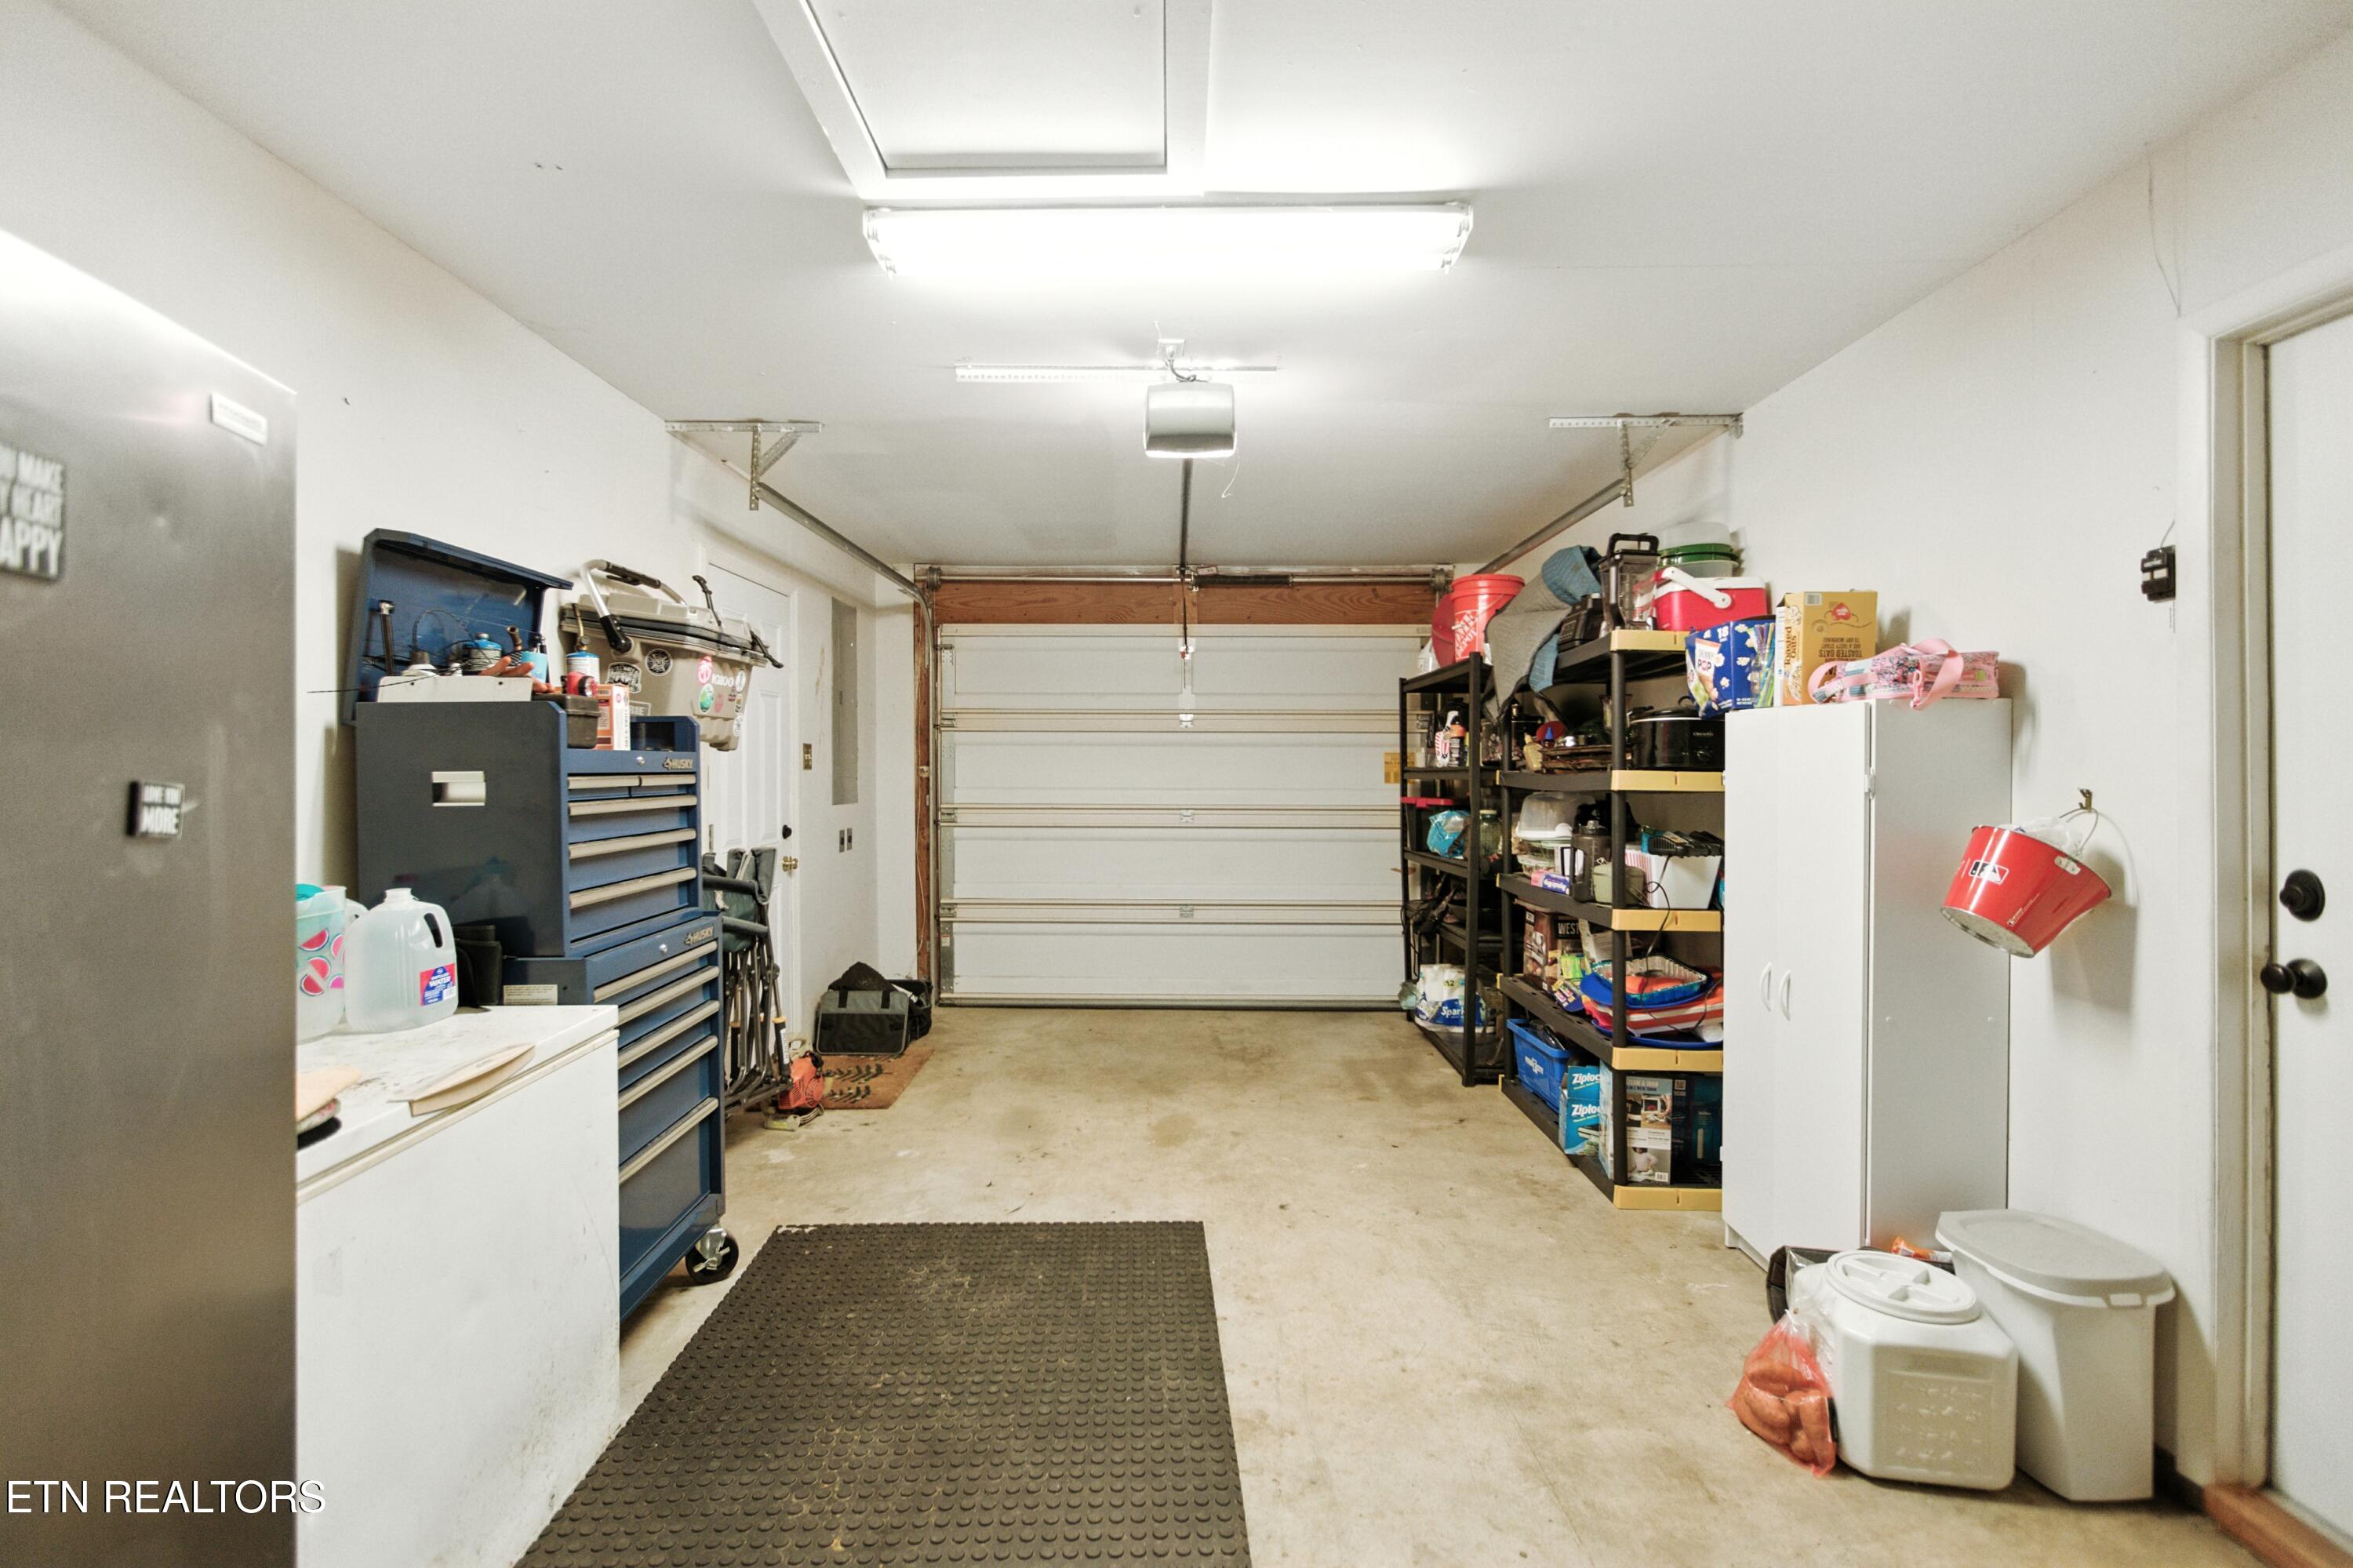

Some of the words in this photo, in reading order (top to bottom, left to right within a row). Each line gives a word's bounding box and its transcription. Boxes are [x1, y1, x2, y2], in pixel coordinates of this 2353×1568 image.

[0, 515, 63, 577] APPY
[1717, 626, 1729, 638] 18
[1698, 659, 1711, 671] POP
[671, 759, 693, 769] HUSKY
[140, 806, 179, 835] MORE
[1558, 922, 1579, 934] WEST
[429, 975, 452, 987] WATER
[1441, 1005, 1464, 1018] Spark
